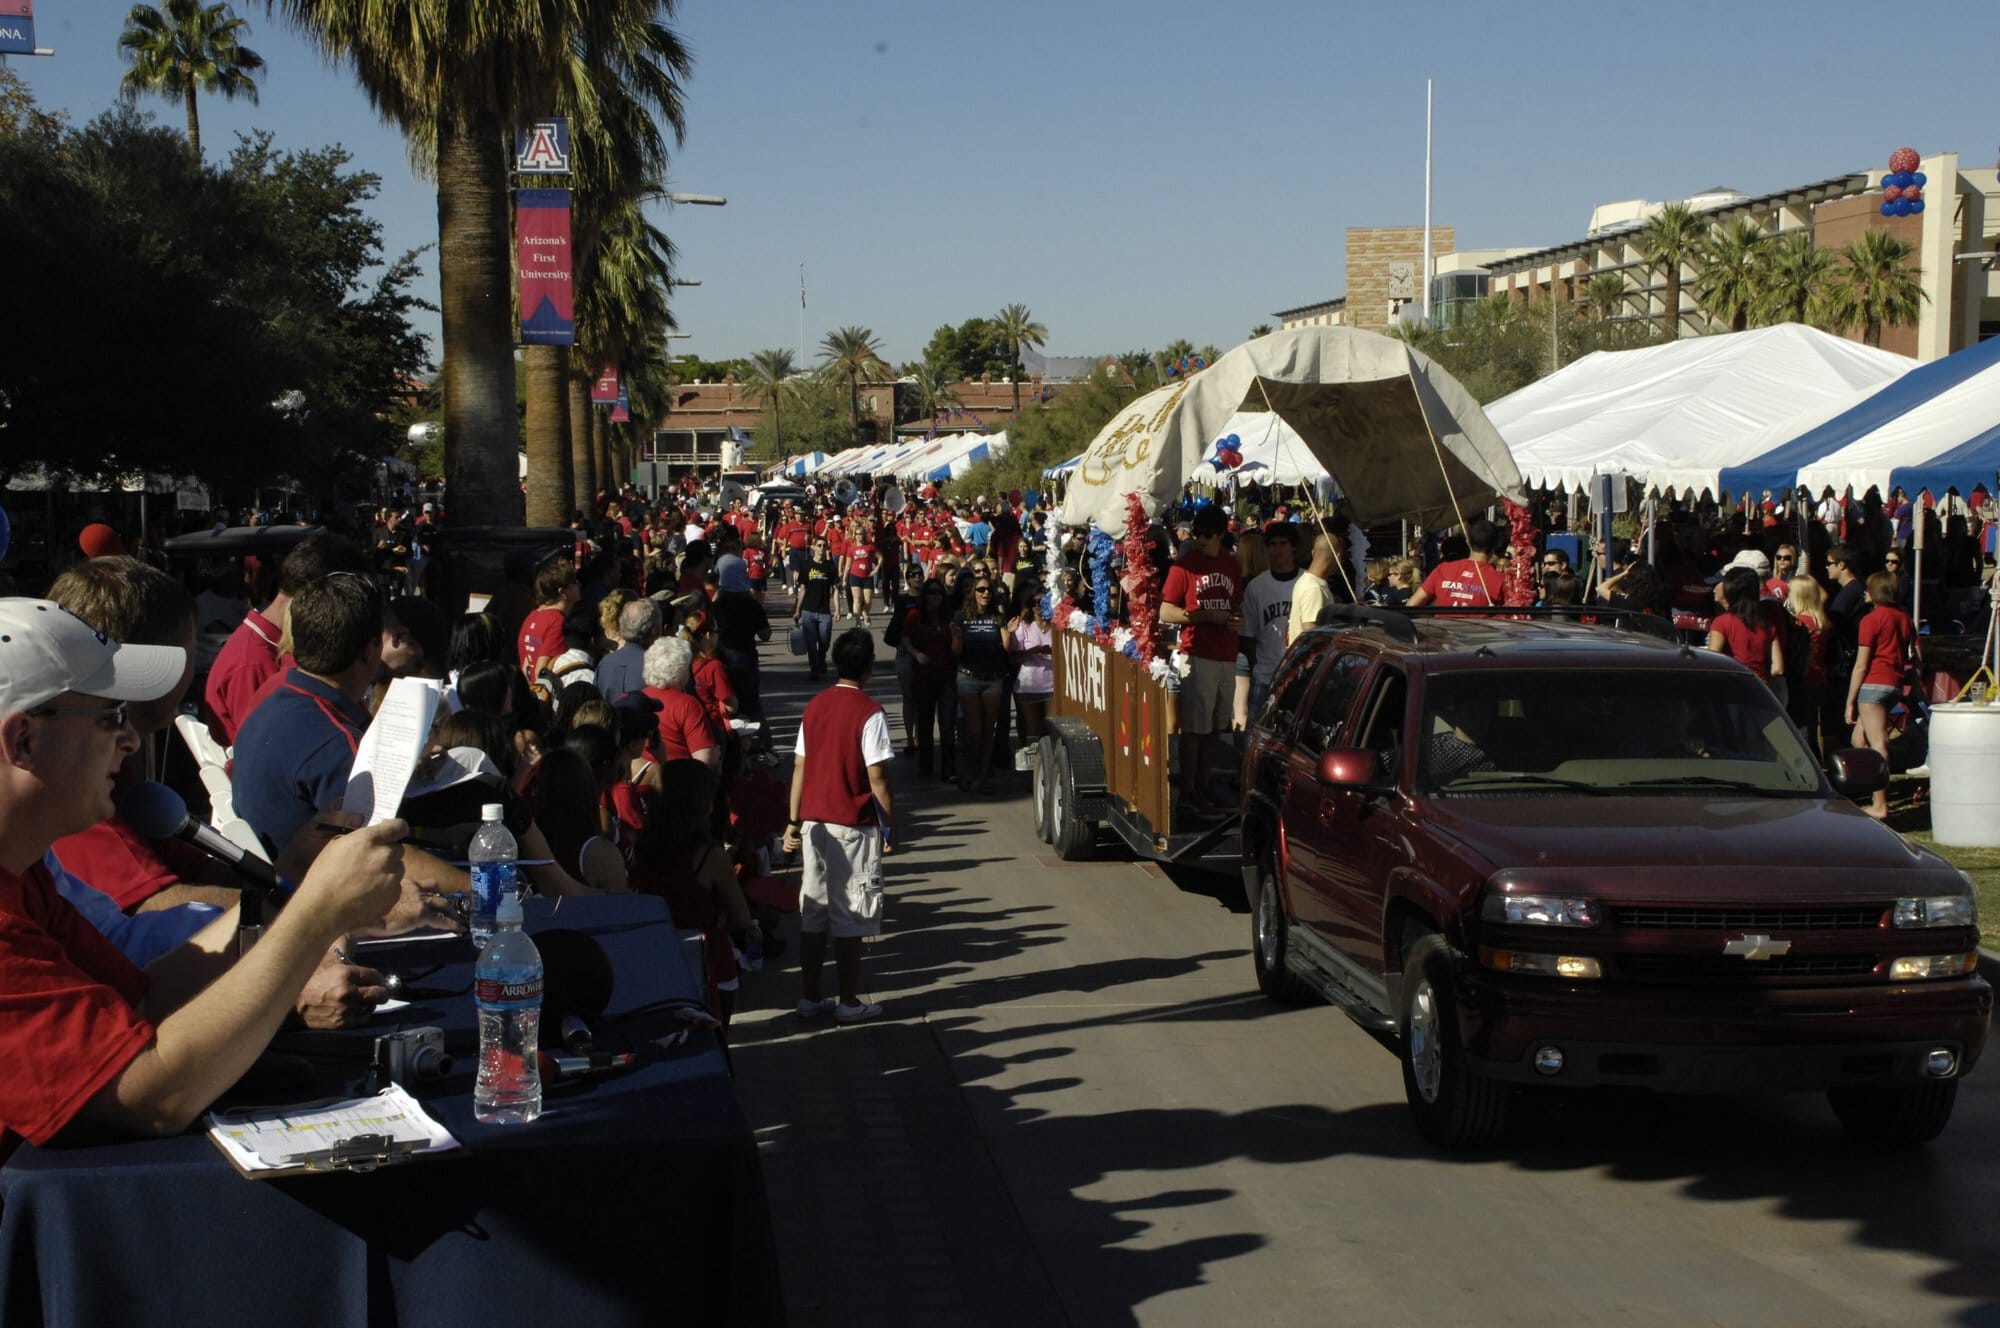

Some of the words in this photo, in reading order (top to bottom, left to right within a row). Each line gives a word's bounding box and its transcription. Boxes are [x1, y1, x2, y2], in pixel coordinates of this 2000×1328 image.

[517, 123, 568, 171] A
[522, 236, 567, 245] Arizona's
[533, 253, 556, 262] First
[520, 270, 571, 281] University.
[1263, 601, 1292, 626] ARIZ
